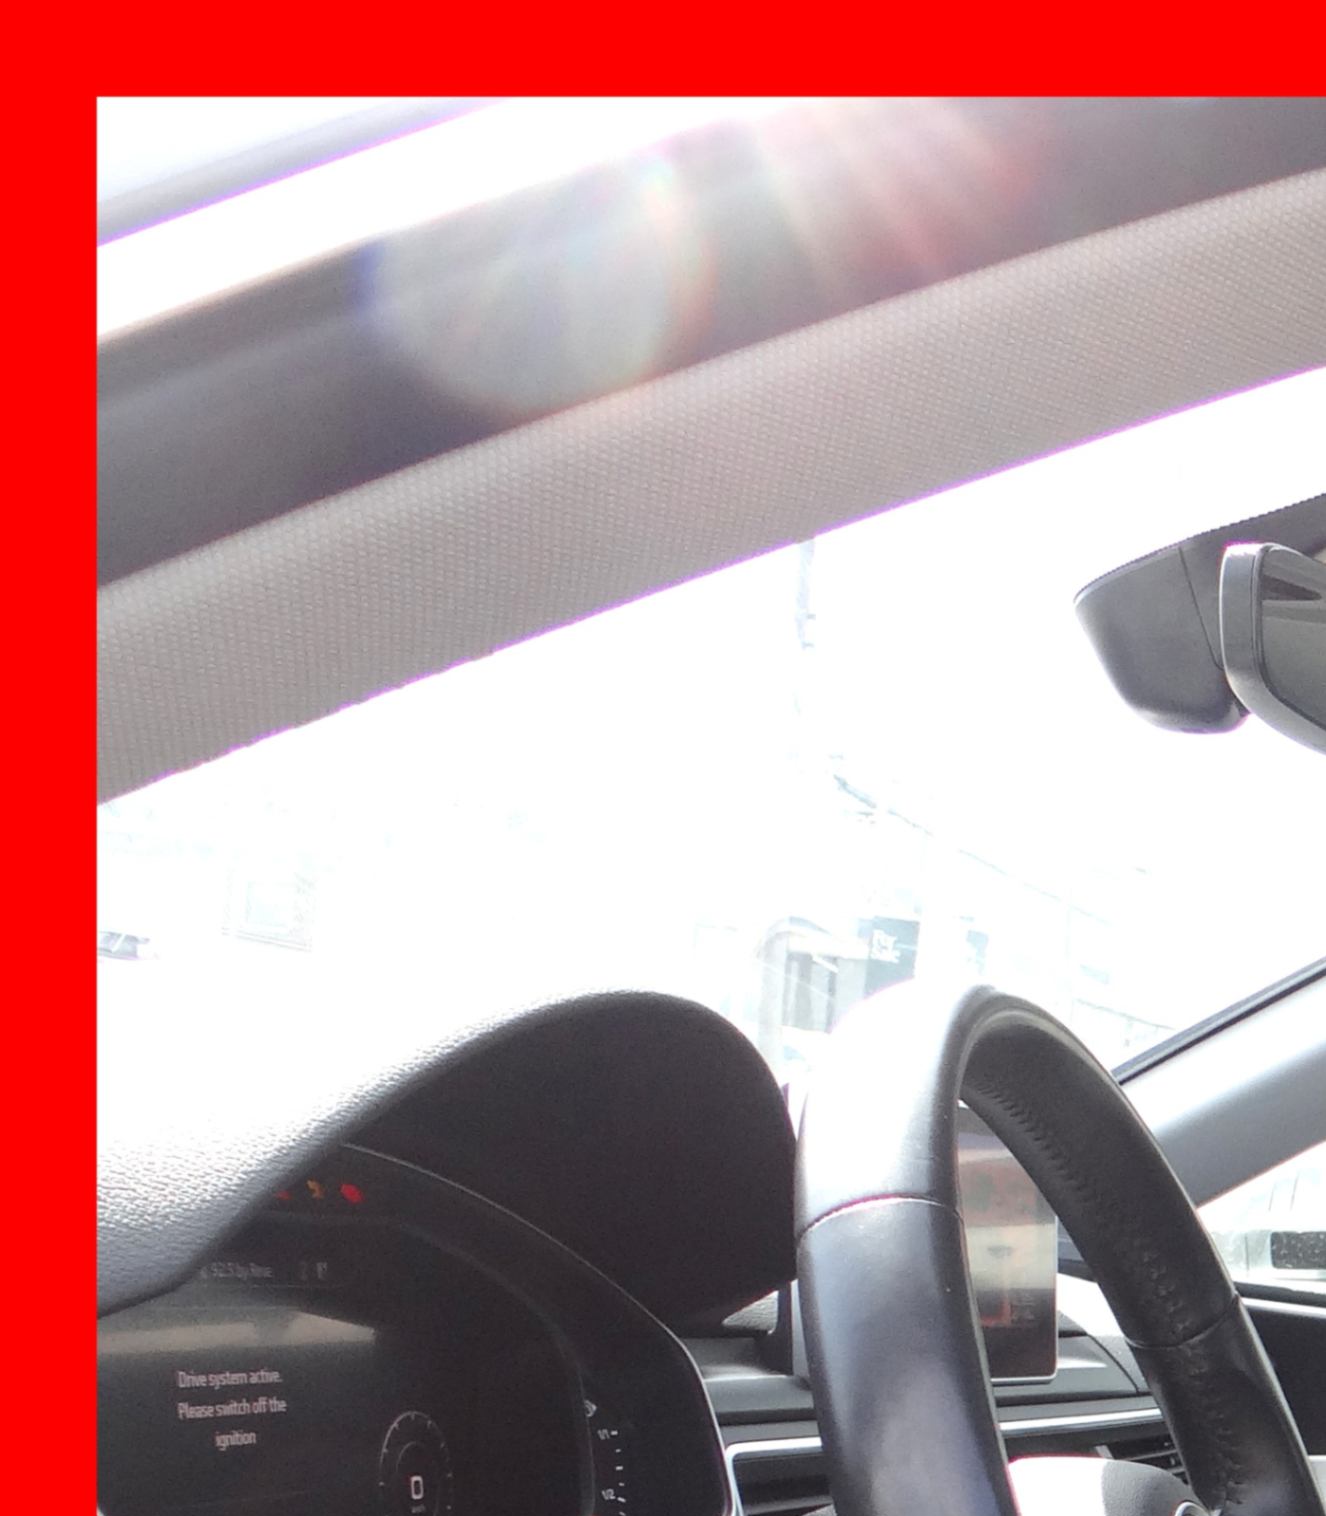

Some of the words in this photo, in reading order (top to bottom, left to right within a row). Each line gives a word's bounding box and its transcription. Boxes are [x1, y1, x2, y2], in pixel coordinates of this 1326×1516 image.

[177, 1370, 207, 1388] Drive
[208, 1371, 248, 1391] system
[249, 1367, 283, 1384] active.
[178, 1401, 214, 1420] Please
[215, 1398, 250, 1417] switch
[252, 1396, 268, 1414] off
[268, 1396, 287, 1413] the
[215, 1429, 256, 1452] ignition
[410, 1475, 424, 1500] 0
